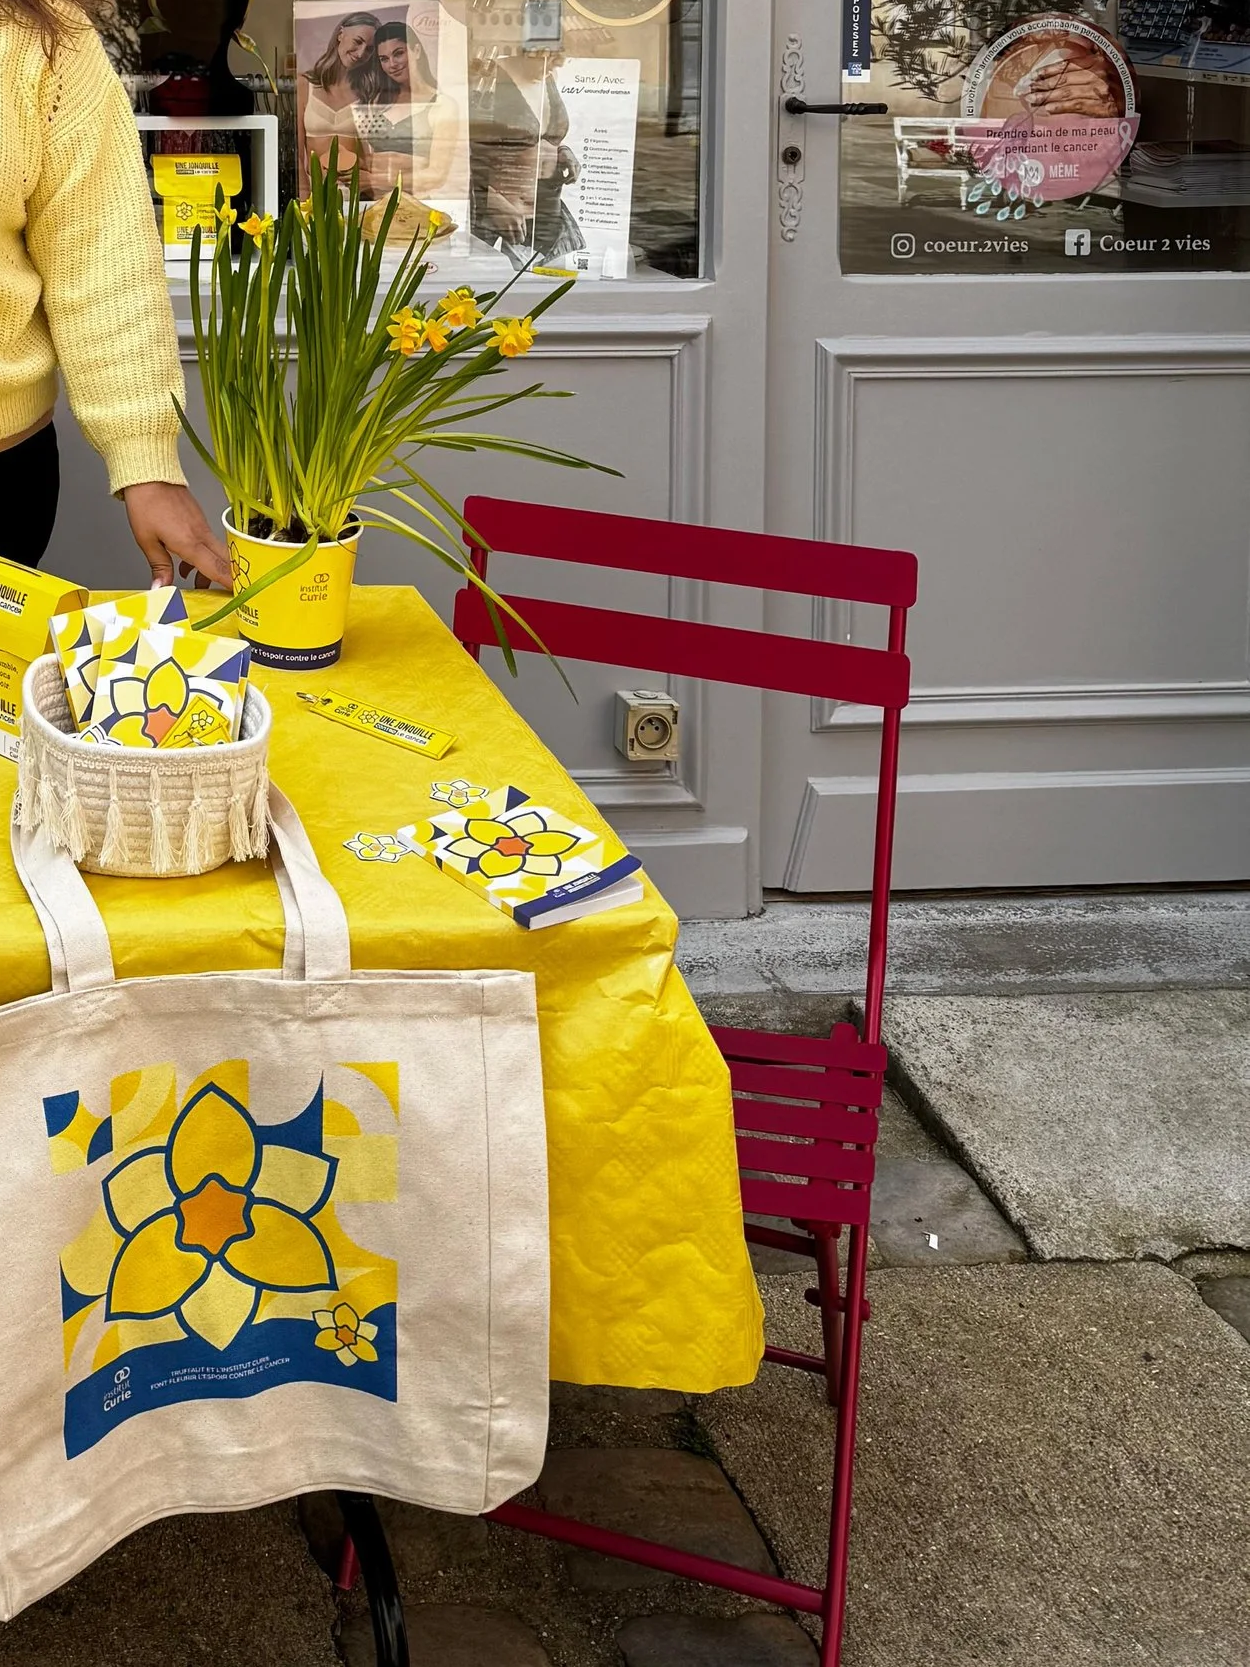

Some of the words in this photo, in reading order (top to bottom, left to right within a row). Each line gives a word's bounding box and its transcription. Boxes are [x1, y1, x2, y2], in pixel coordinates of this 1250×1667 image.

[1007, 25, 1027, 41] vous
[1027, 20, 1080, 32] accompagne
[1080, 26, 1111, 51] pendant
[975, 37, 1006, 80] pharmacien
[1108, 48, 1121, 65] vos
[574, 75, 596, 83] Sans
[603, 76, 625, 84] Avec
[1117, 62, 1134, 112] traitements
[968, 80, 978, 106] votre
[966, 105, 974, 117] Ici
[986, 129, 1028, 139] Prendre
[1030, 128, 1052, 138] soin
[1055, 126, 1068, 137] de
[1071, 127, 1088, 136] ma
[1091, 125, 1116, 137] peau
[1004, 142, 1048, 154] pendant
[1051, 142, 1060, 152] le
[1063, 143, 1098, 153] cancer
[1049, 162, 1080, 178] MÊME
[924, 236, 1029, 254] coeur.2vies
[1099, 234, 1158, 252] Coeur
[1161, 239, 1171, 252] 2
[1175, 234, 1211, 252] vies
[299, 584, 328, 592] institut
[299, 592, 328, 602] Curie
[258, 648, 283, 661] l'espoir
[285, 653, 309, 662] contre
[310, 653, 317, 661] le
[379, 715, 396, 727] UNE
[396, 718, 436, 741] JONQUILLE
[251, 1355, 270, 1367] CURIE
[150, 1380, 168, 1391] FONT
[168, 1374, 197, 1385] FLEURIR
[228, 1368, 256, 1380] CONTRE
[256, 1364, 264, 1373] LE
[264, 1357, 291, 1369] CANCER
[103, 1390, 132, 1412] Curie
